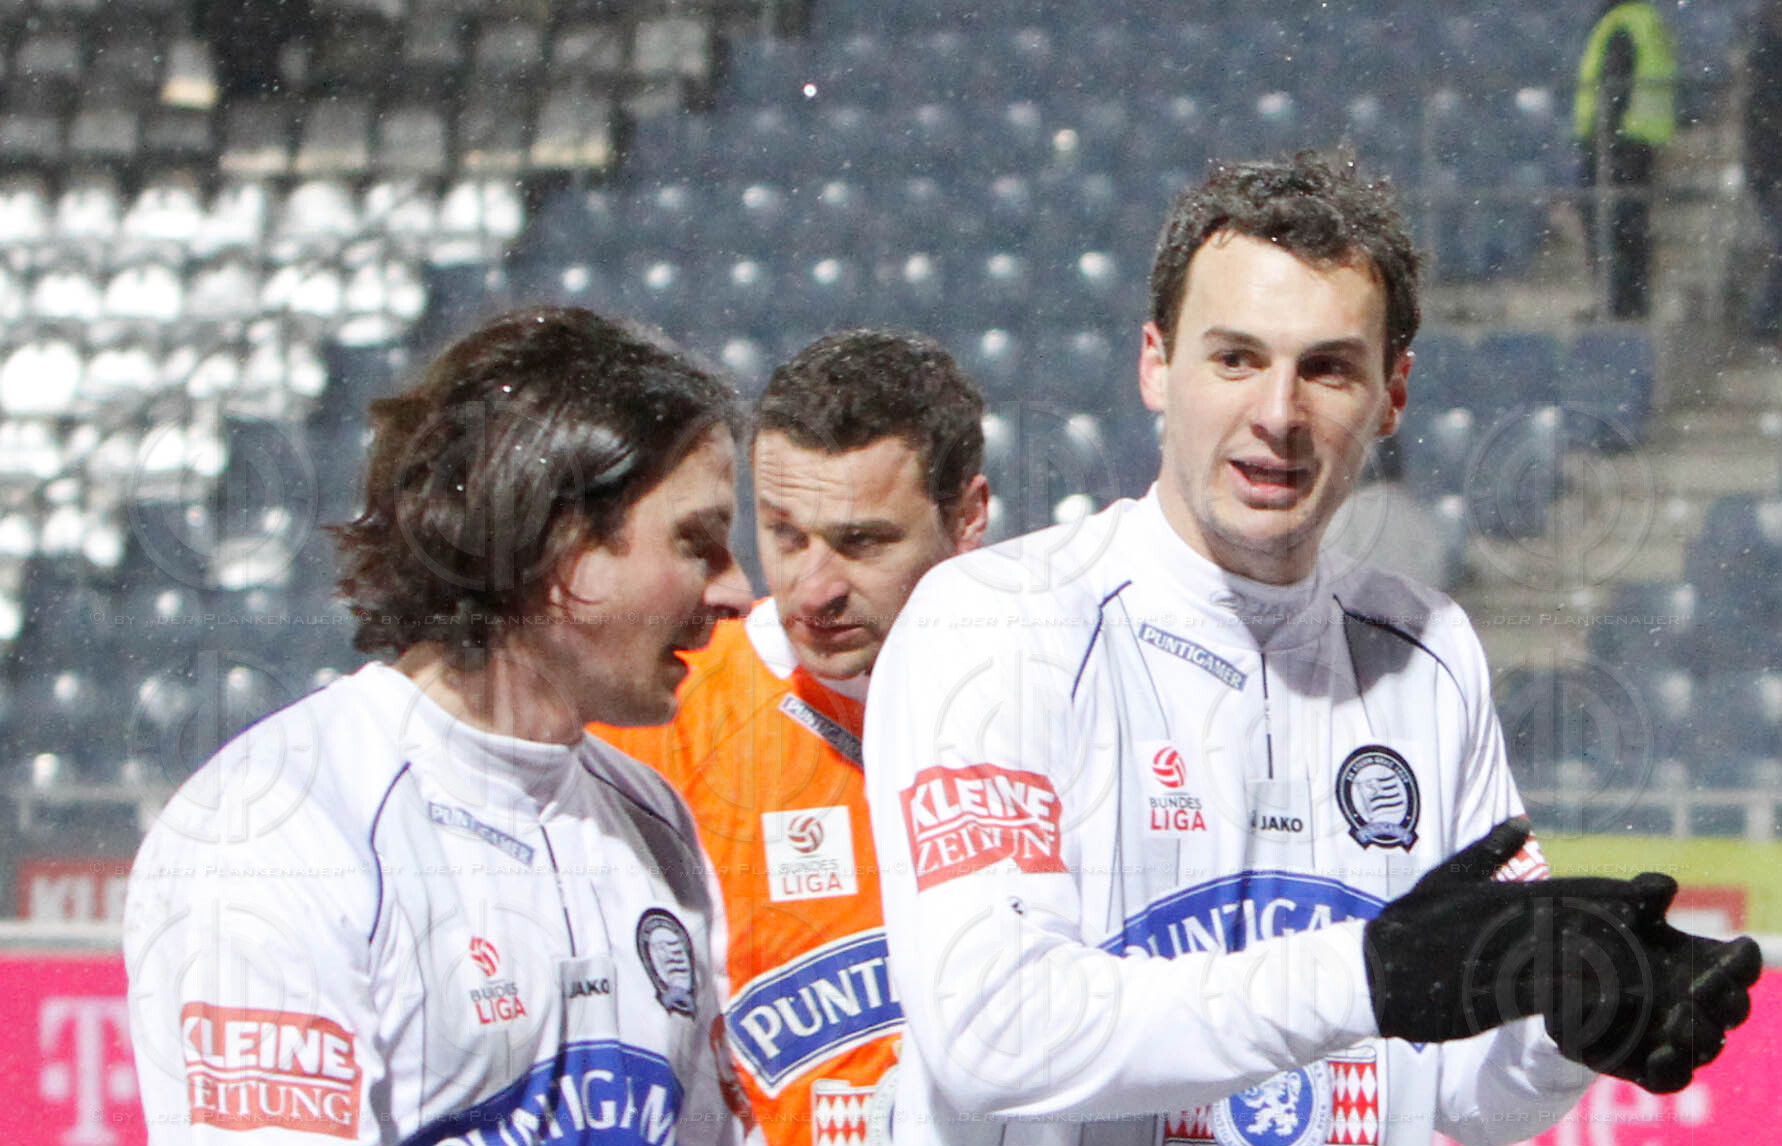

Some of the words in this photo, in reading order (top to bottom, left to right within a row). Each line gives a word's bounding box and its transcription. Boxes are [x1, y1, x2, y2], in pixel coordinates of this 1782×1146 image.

[1142, 625, 1244, 690] PUNTIGAMER
[910, 775, 1057, 833] KLEINE
[1150, 797, 1202, 810] BUNDES
[1150, 809, 1207, 831] LIGA
[1260, 815, 1303, 833] JAKO
[782, 872, 843, 895] LIGA
[569, 979, 611, 999] JAKO
[475, 996, 528, 1025] LIGA
[183, 1016, 356, 1080] KLEINE
[190, 1077, 352, 1126] EITUNG
